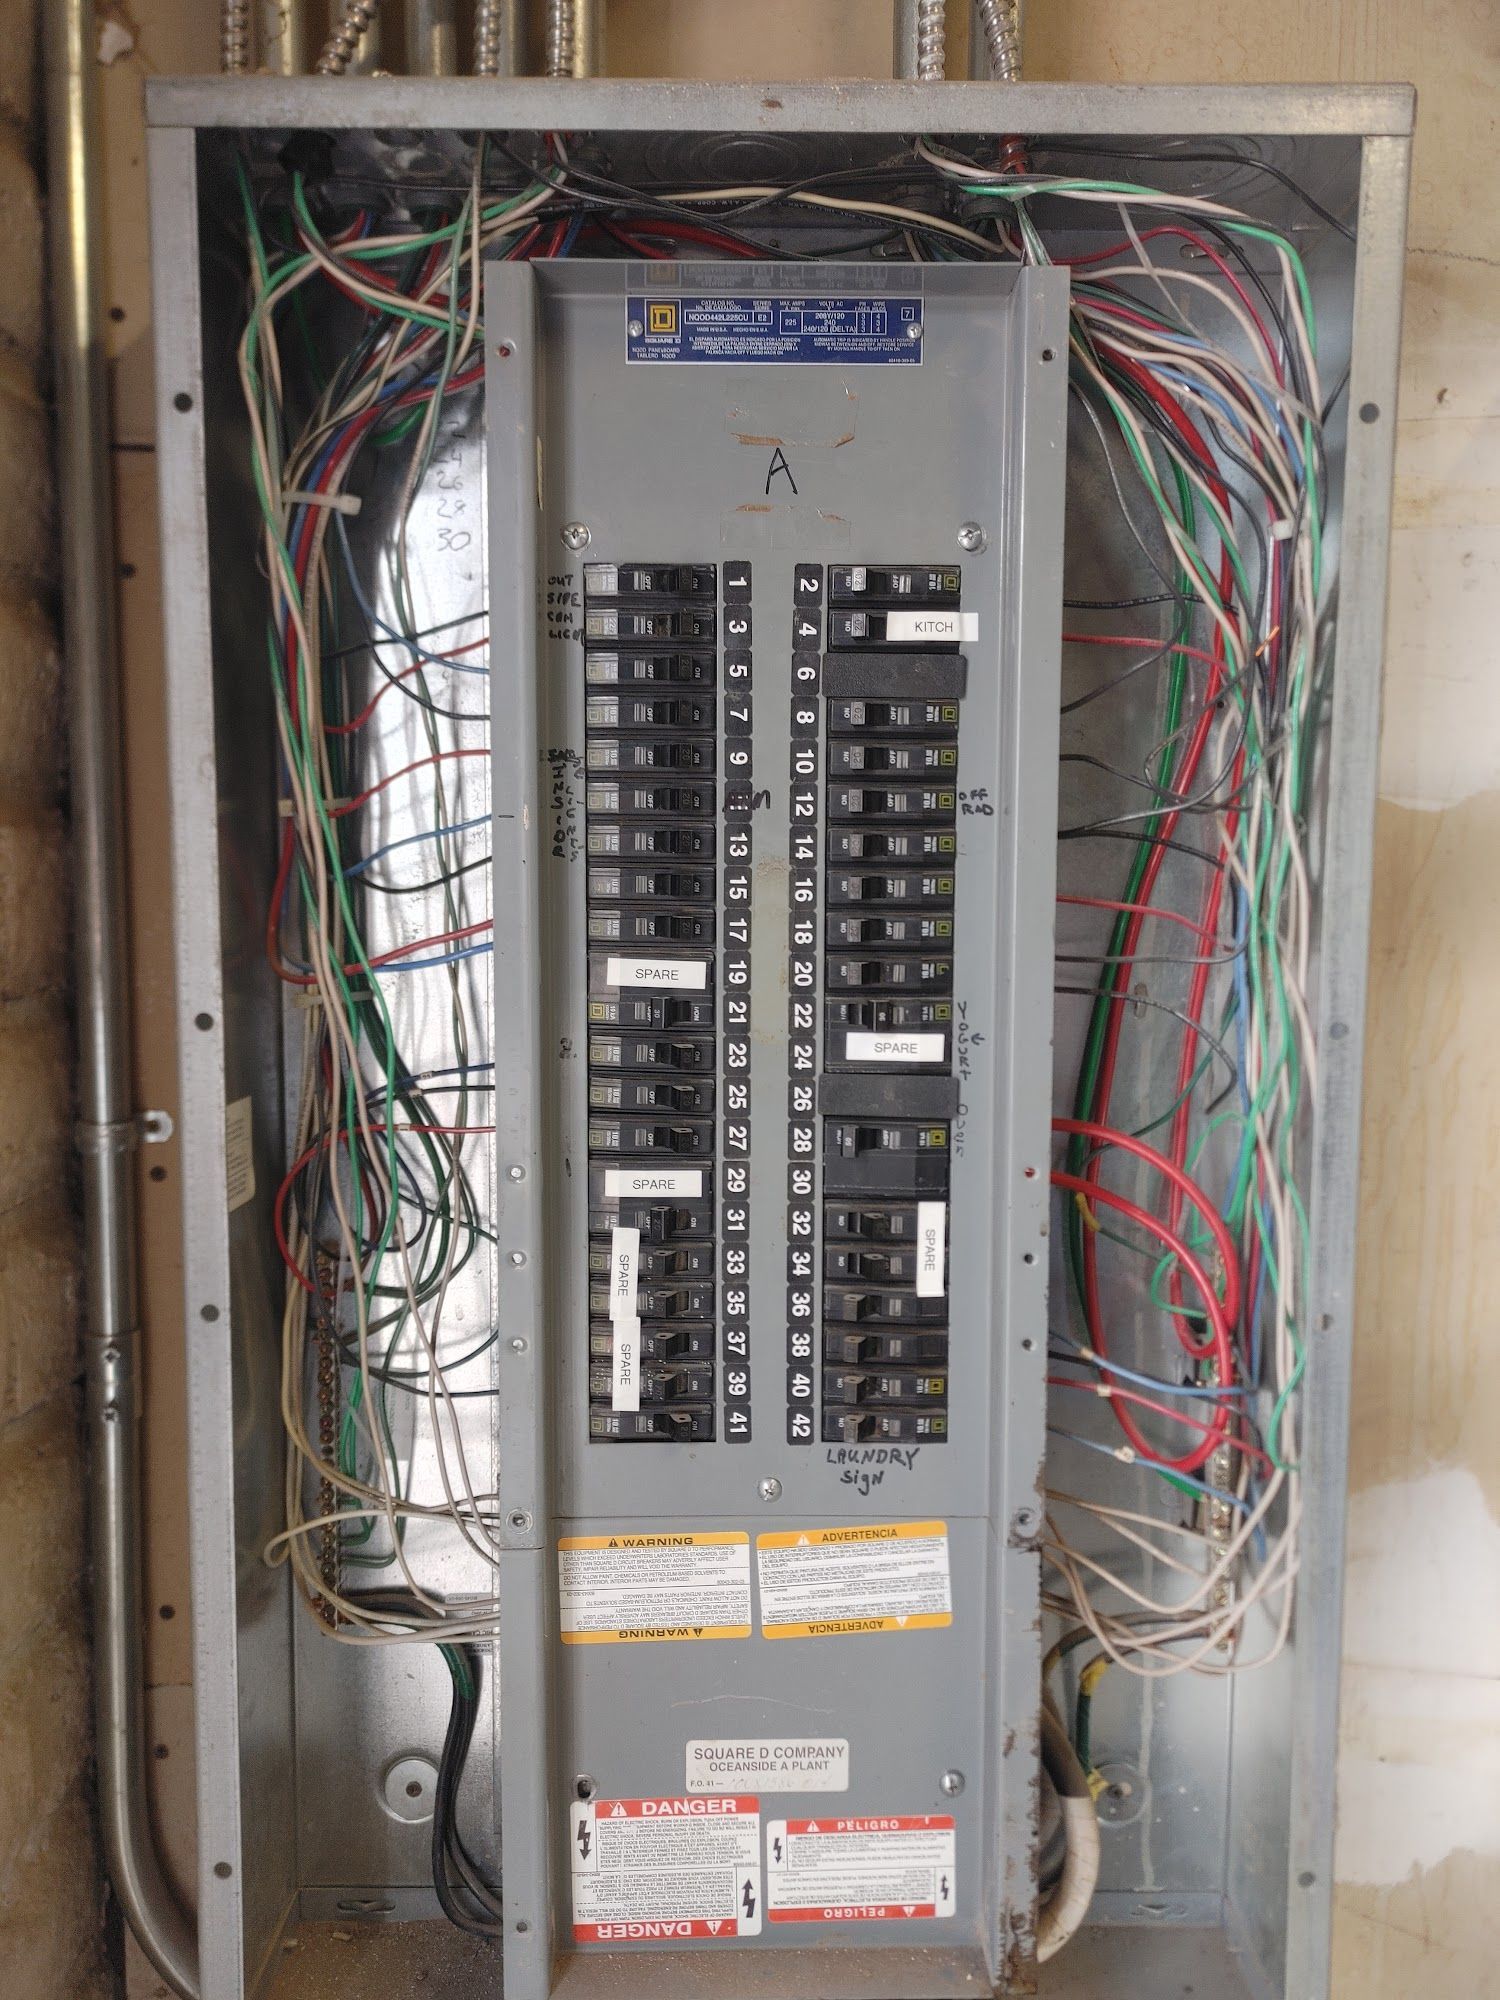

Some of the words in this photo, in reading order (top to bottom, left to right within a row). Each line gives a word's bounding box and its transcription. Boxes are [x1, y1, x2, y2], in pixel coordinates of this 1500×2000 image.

[766, 447, 798, 495] A
[436, 470, 464, 491] 26
[436, 528, 472, 552] 30
[548, 574, 574, 587] OUT
[692, 578, 698, 589] ON
[729, 577, 747, 586] 1
[800, 579, 819, 592] 2
[846, 576, 852, 587] ON
[694, 623, 700, 635] ON
[729, 621, 747, 633] 3
[799, 623, 817, 637] 4
[845, 621, 852, 632] ON
[915, 622, 953, 632] KITCH
[694, 667, 700, 678] ON
[729, 665, 748, 677] 5
[797, 667, 815, 680] 6
[694, 710, 700, 720] ON
[730, 709, 748, 721] 7
[796, 711, 815, 724] 8
[844, 708, 850, 718] ON
[694, 752, 700, 764] ON
[730, 752, 748, 765] 9
[796, 749, 814, 773] 10
[844, 751, 850, 762] ON
[694, 796, 700, 807] ON
[841, 794, 848, 806] ON
[958, 788, 988, 800] OFF
[795, 793, 814, 817] 12
[730, 833, 748, 857] 13
[795, 835, 813, 859] 14
[842, 838, 848, 850] ON
[730, 876, 748, 900] 15
[795, 878, 813, 902] 16
[729, 918, 748, 942] 17
[794, 921, 813, 945] 18
[635, 968, 679, 980] SPARE
[729, 961, 747, 985] 19
[794, 962, 812, 986] 20
[729, 1002, 747, 1023] 21
[794, 1004, 812, 1028] 22
[729, 1043, 747, 1068] 23
[874, 1042, 918, 1054] SPARE
[794, 1045, 812, 1069] 24
[729, 1085, 747, 1109] 25
[793, 1087, 812, 1111] 26
[728, 1126, 747, 1151] 27
[793, 1128, 812, 1152] 28
[632, 1180, 676, 1190] SPARE
[728, 1168, 746, 1193] 29
[793, 1170, 811, 1194] 30
[691, 1217, 697, 1228] ON
[727, 1209, 745, 1231] 31
[792, 1211, 811, 1236] 32
[924, 1228, 936, 1272] SPARE
[727, 1251, 745, 1275] 33
[792, 1252, 811, 1277] 34
[618, 1254, 630, 1296] SPARE
[694, 1298, 700, 1308] ON
[727, 1291, 746, 1315] 35
[792, 1293, 810, 1317] 36
[692, 1340, 699, 1351] ON
[728, 1332, 746, 1356] 37
[792, 1333, 810, 1357] 38
[620, 1344, 630, 1384] SPARE
[728, 1372, 746, 1396] 39
[792, 1374, 810, 1398] 40
[692, 1421, 698, 1431] ON
[729, 1412, 747, 1433] 41
[792, 1414, 810, 1438] 42
[826, 1447, 920, 1471] LAUNDRY
[623, 1537, 694, 1548] WARNING
[822, 1528, 898, 1542] ADVERTENCIA
[618, 1628, 689, 1639] WARNING
[808, 1620, 884, 1633] ADVERTENCIA
[694, 1747, 754, 1760] SQUARE
[760, 1747, 769, 1758] D
[774, 1746, 844, 1758] COMPANY
[710, 1761, 777, 1772] OCEANSIDE
[780, 1762, 788, 1770] A
[792, 1760, 830, 1770] PLANT
[641, 1799, 737, 1816] DANGER
[837, 1820, 900, 1831] PELIGRO
[824, 1906, 886, 1918] PELIGRO
[597, 1921, 692, 1938] DANGER
